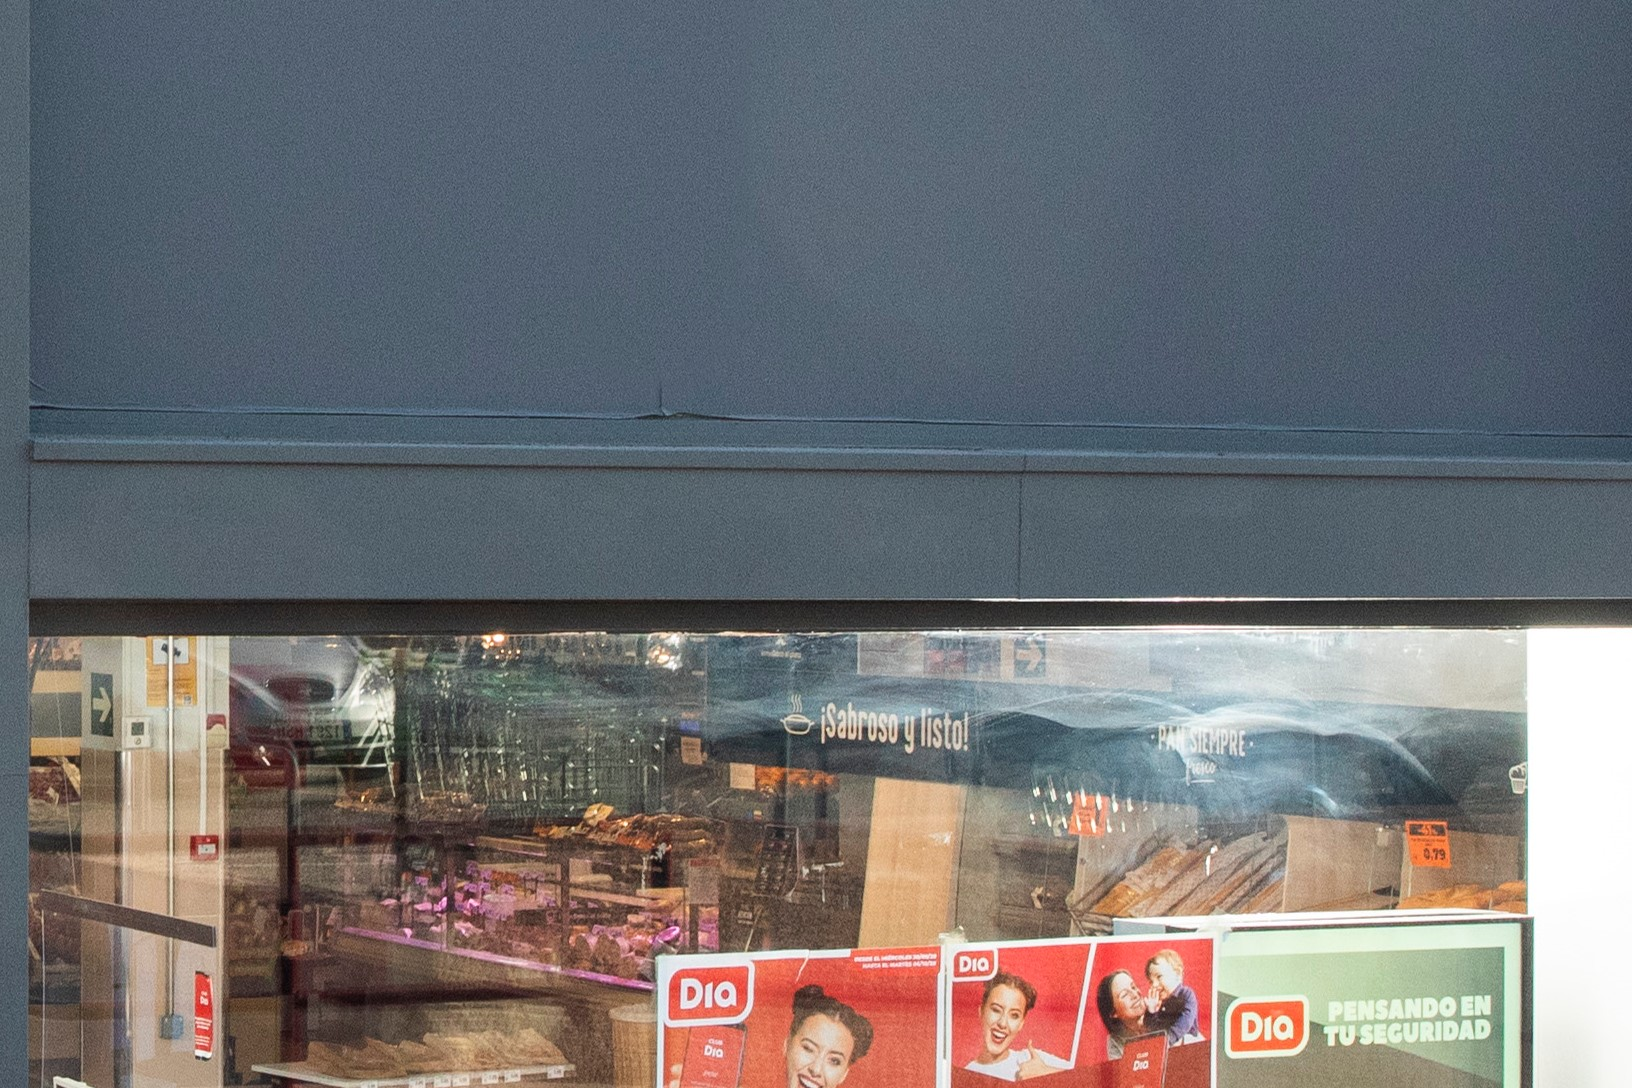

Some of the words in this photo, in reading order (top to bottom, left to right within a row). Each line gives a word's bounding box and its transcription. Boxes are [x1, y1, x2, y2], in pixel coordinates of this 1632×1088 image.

[821, 702, 898, 744] ¡Sabroso
[904, 713, 915, 754] y
[921, 707, 968, 751] listo!
[1191, 728, 1246, 757] SIEMPRE
[1328, 996, 1457, 1022] PENSANDO
[1460, 995, 1492, 1016] EN
[1323, 1025, 1355, 1046] TU
[1359, 1019, 1492, 1045] SEGURIDAD
